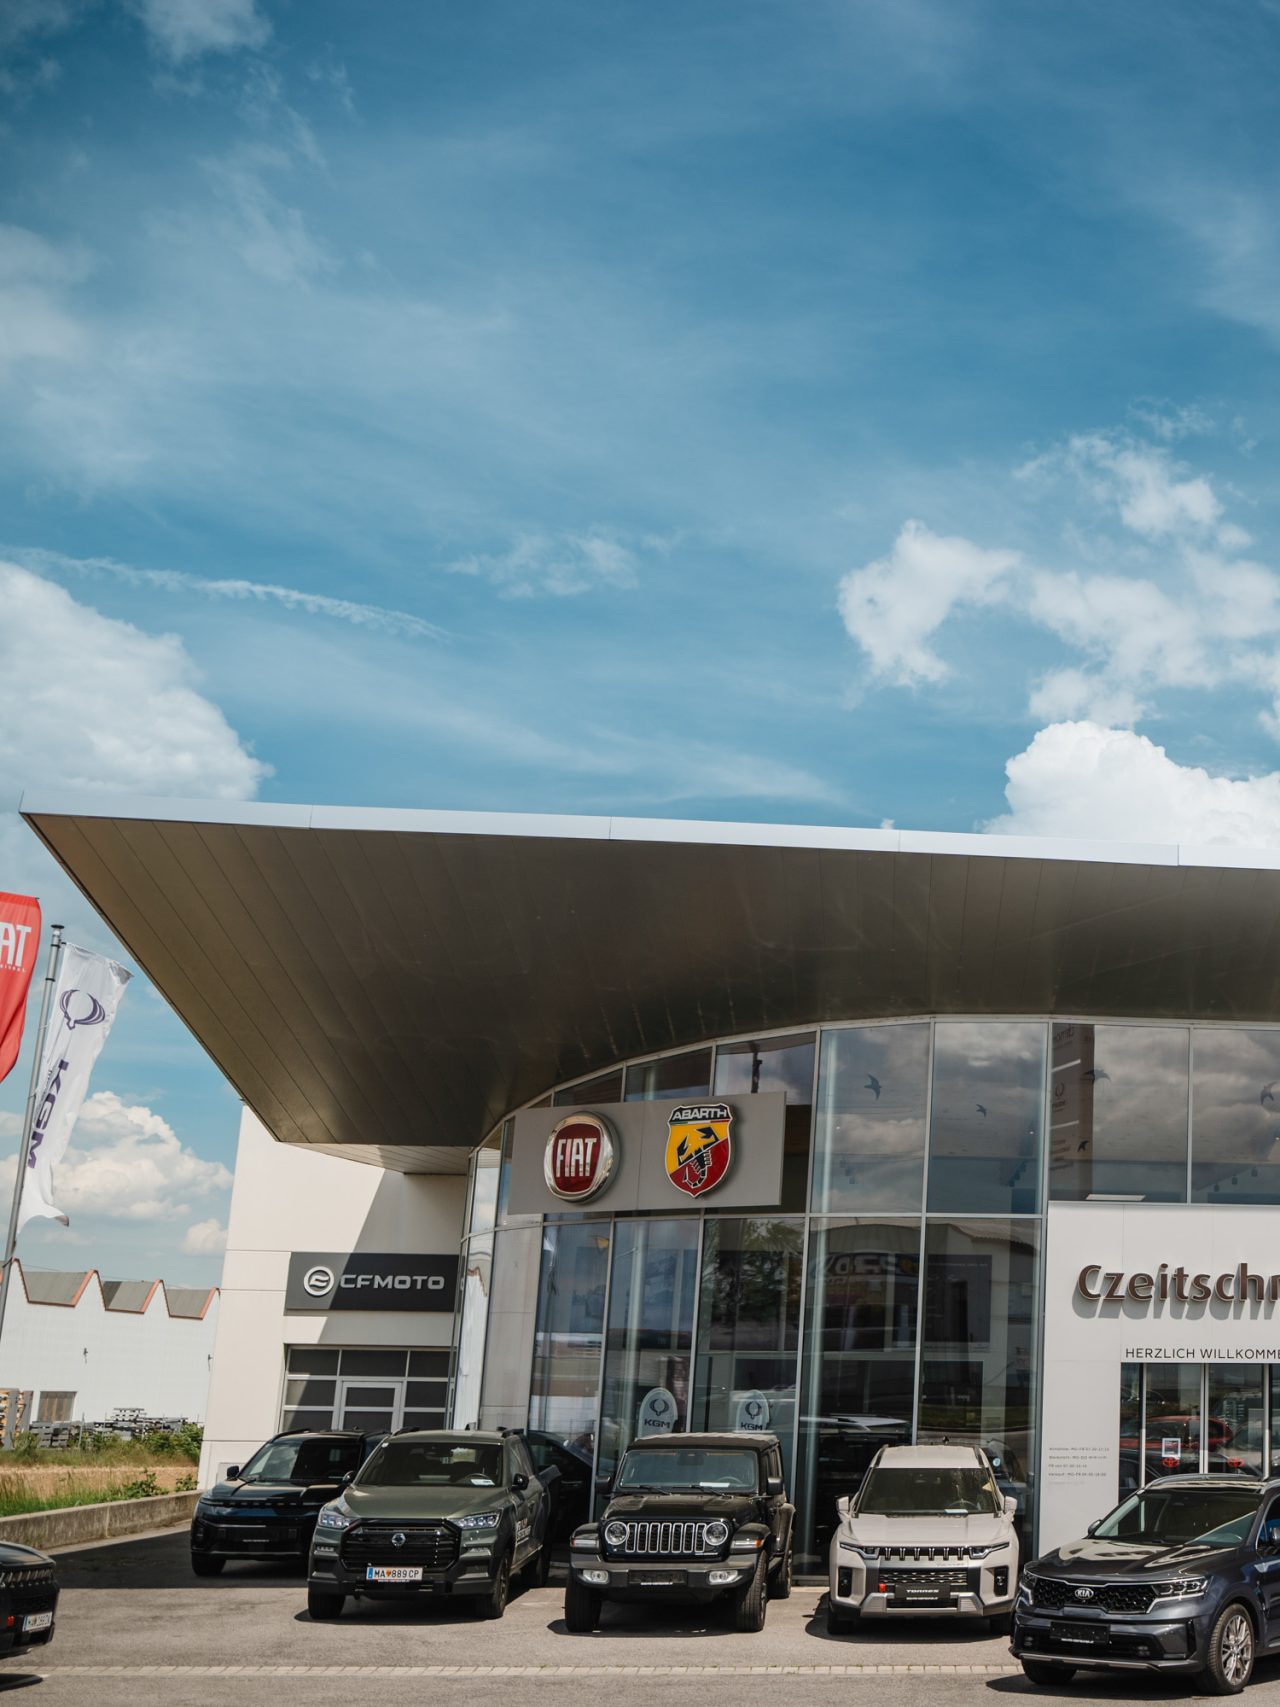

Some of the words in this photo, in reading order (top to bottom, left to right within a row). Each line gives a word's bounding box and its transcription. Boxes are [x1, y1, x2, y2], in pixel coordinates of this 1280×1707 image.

[671, 1107, 728, 1121] ABARTH
[555, 1137, 598, 1179] FIAT
[340, 1274, 445, 1290] CFMOTO
[1125, 1348, 1196, 1359] HERZLICH
[644, 1418, 671, 1429] KGM
[740, 1422, 763, 1431] KGM
[374, 1569, 386, 1579] MA
